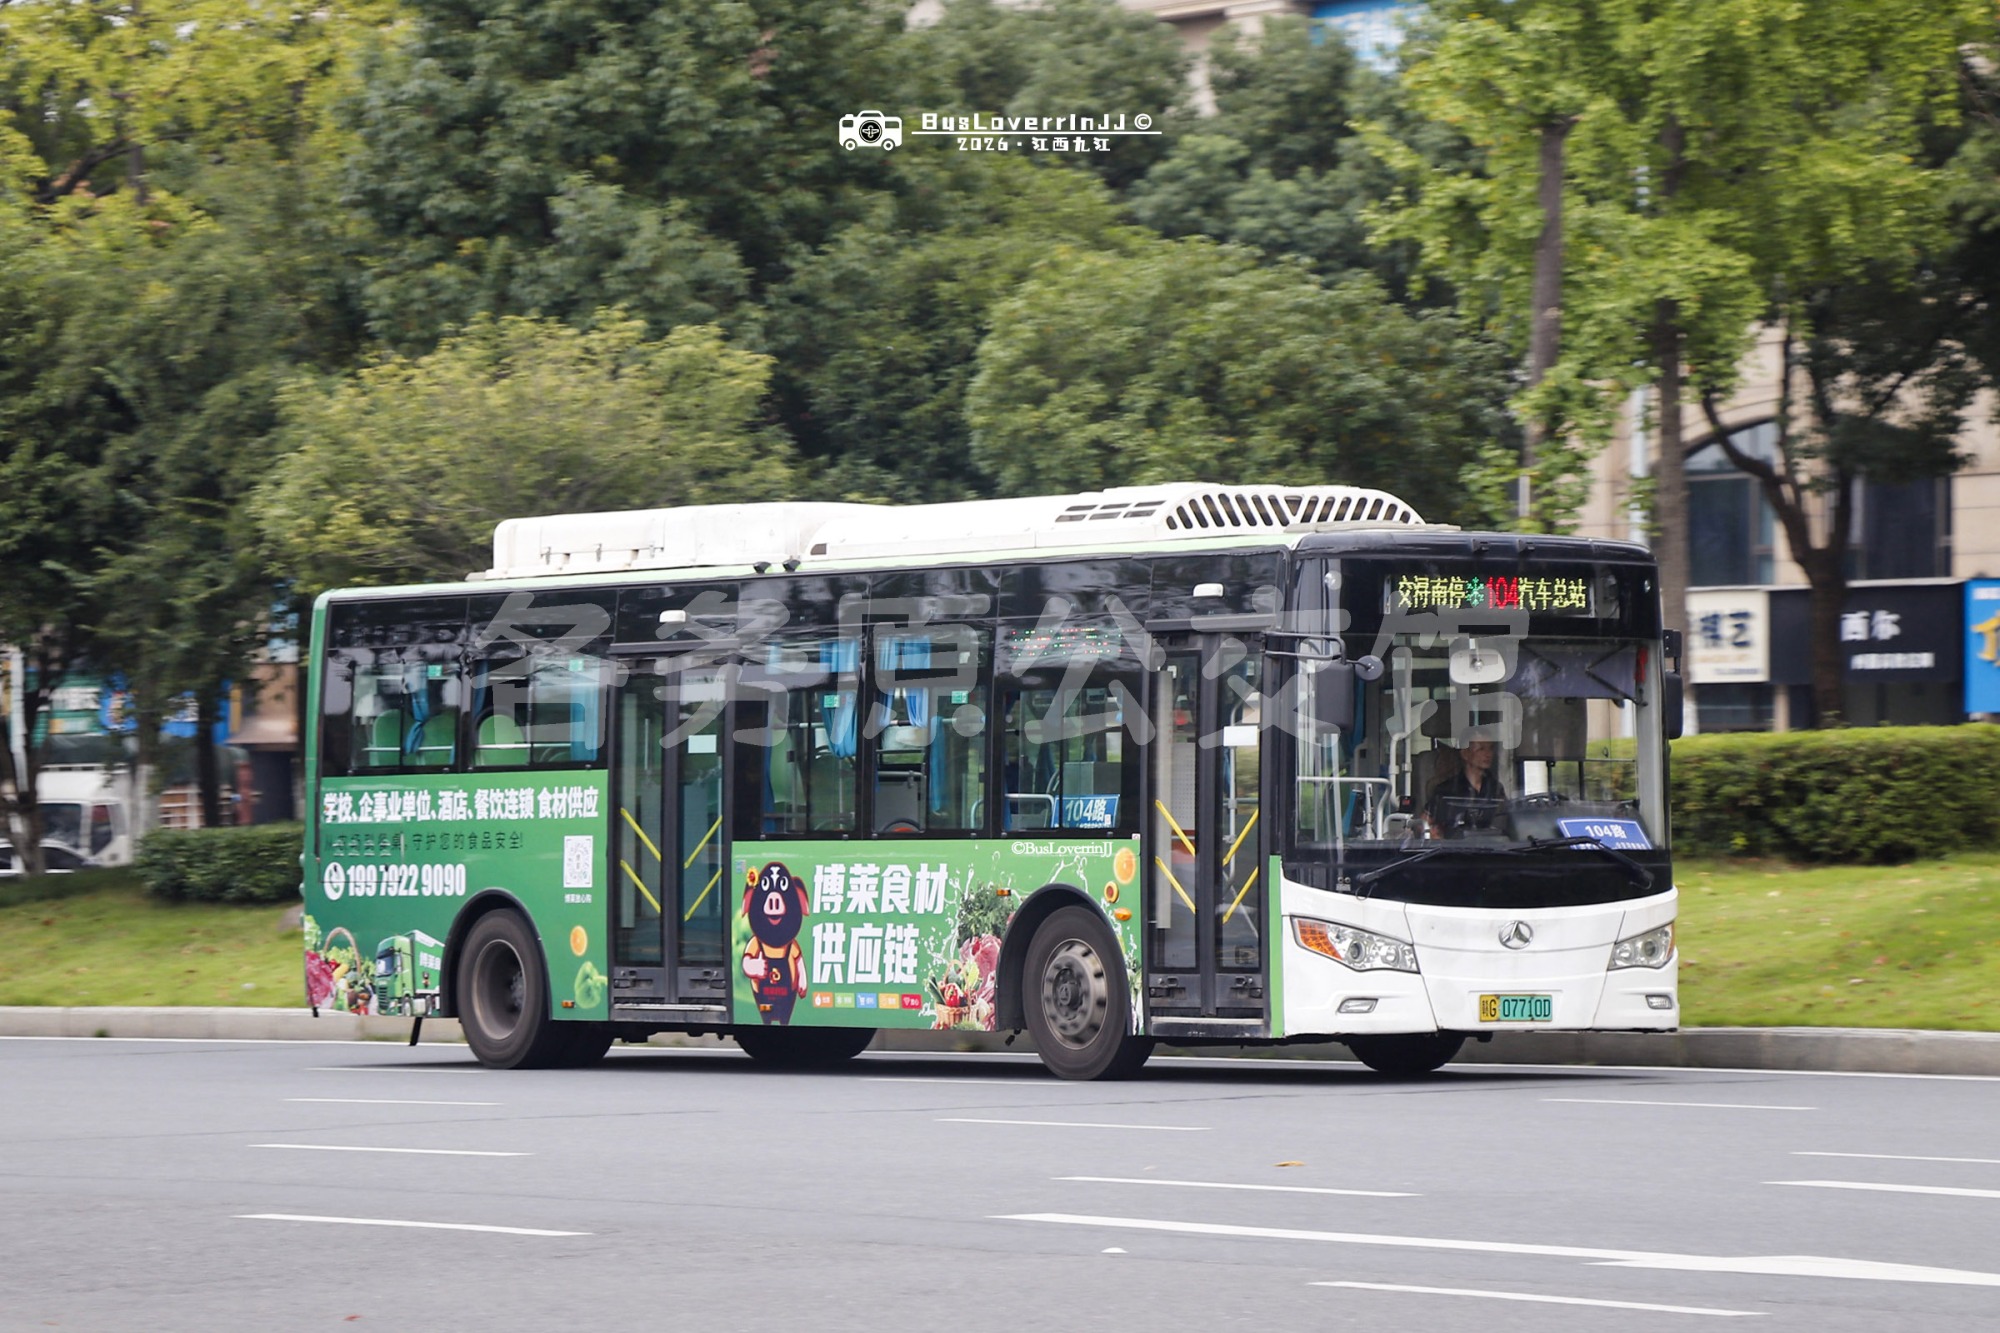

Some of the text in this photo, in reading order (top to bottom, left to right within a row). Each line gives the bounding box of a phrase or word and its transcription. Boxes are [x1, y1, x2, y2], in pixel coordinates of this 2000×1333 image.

[537, 786, 599, 819] 食材供应
[1065, 798, 1107, 822] 104路
[1585, 824, 1627, 839] 104路
[346, 864, 377, 897] 199
[421, 863, 466, 897] 9090
[812, 862, 949, 914] 博莱食材
[812, 922, 920, 984] 供应链
